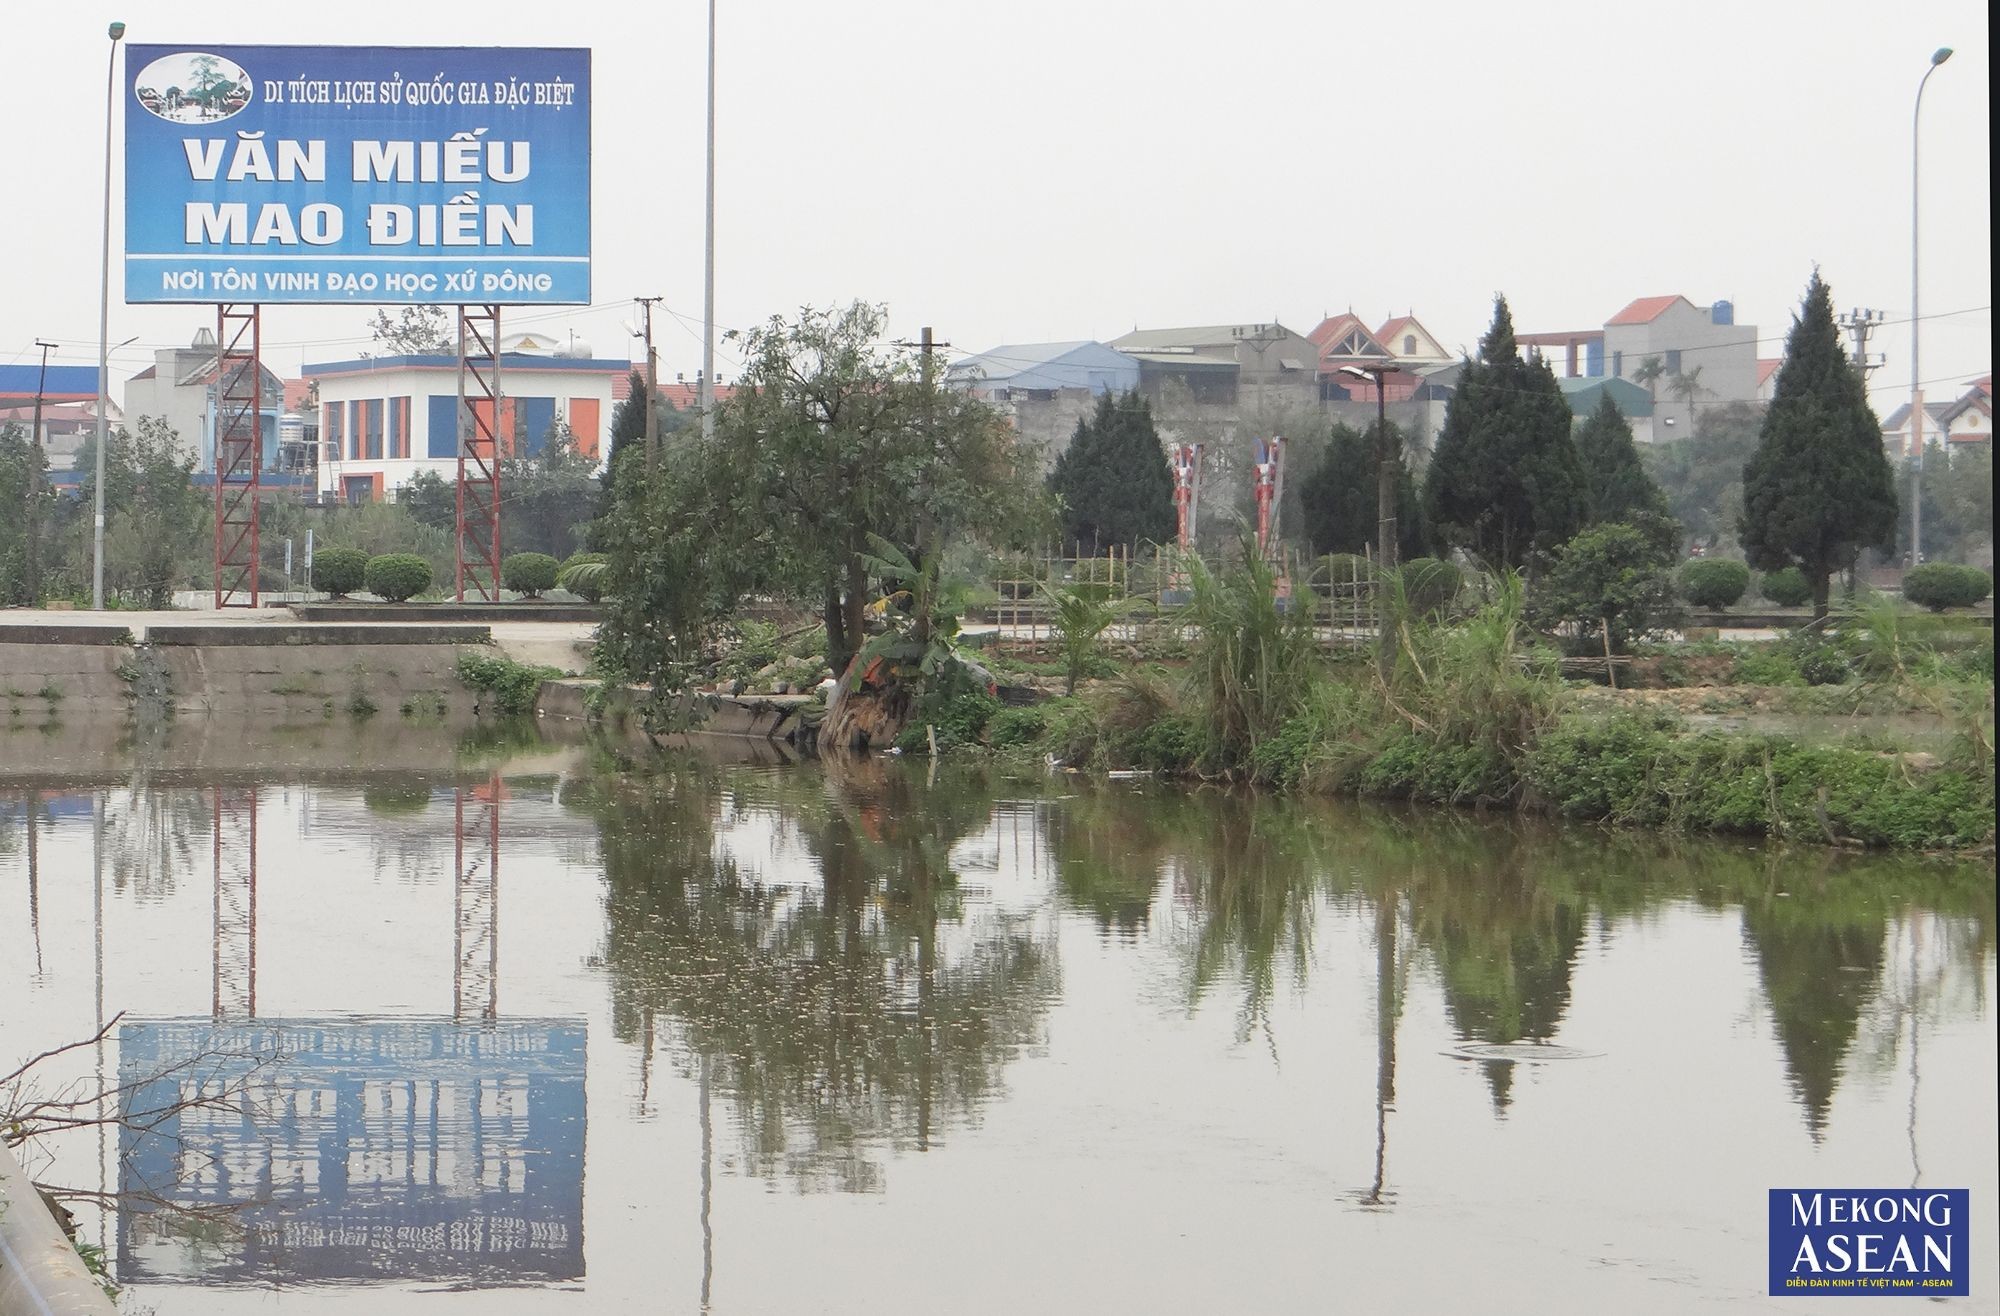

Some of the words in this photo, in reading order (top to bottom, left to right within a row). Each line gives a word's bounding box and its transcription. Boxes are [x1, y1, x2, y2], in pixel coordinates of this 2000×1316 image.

[264, 80, 284, 103] DI
[288, 73, 331, 104] TÍCH
[334, 81, 376, 110] LỊCH
[379, 71, 403, 105] SỬ
[405, 71, 454, 106] QUỐC
[458, 82, 490, 105] GIA
[494, 76, 531, 111] ĐẶC
[534, 75, 575, 111] BIỆT
[183, 130, 326, 182] VĂN
[353, 127, 530, 183] MIẾU
[185, 202, 344, 245] MAO
[367, 190, 533, 246] ĐIỀN
[163, 268, 205, 290] NƠI
[211, 267, 257, 290] TÔN
[264, 272, 319, 291] VINH
[326, 272, 378, 296] ĐẠO
[385, 273, 438, 297] HỌC
[444, 268, 477, 292] XỨ
[482, 268, 553, 292] ĐÔNG
